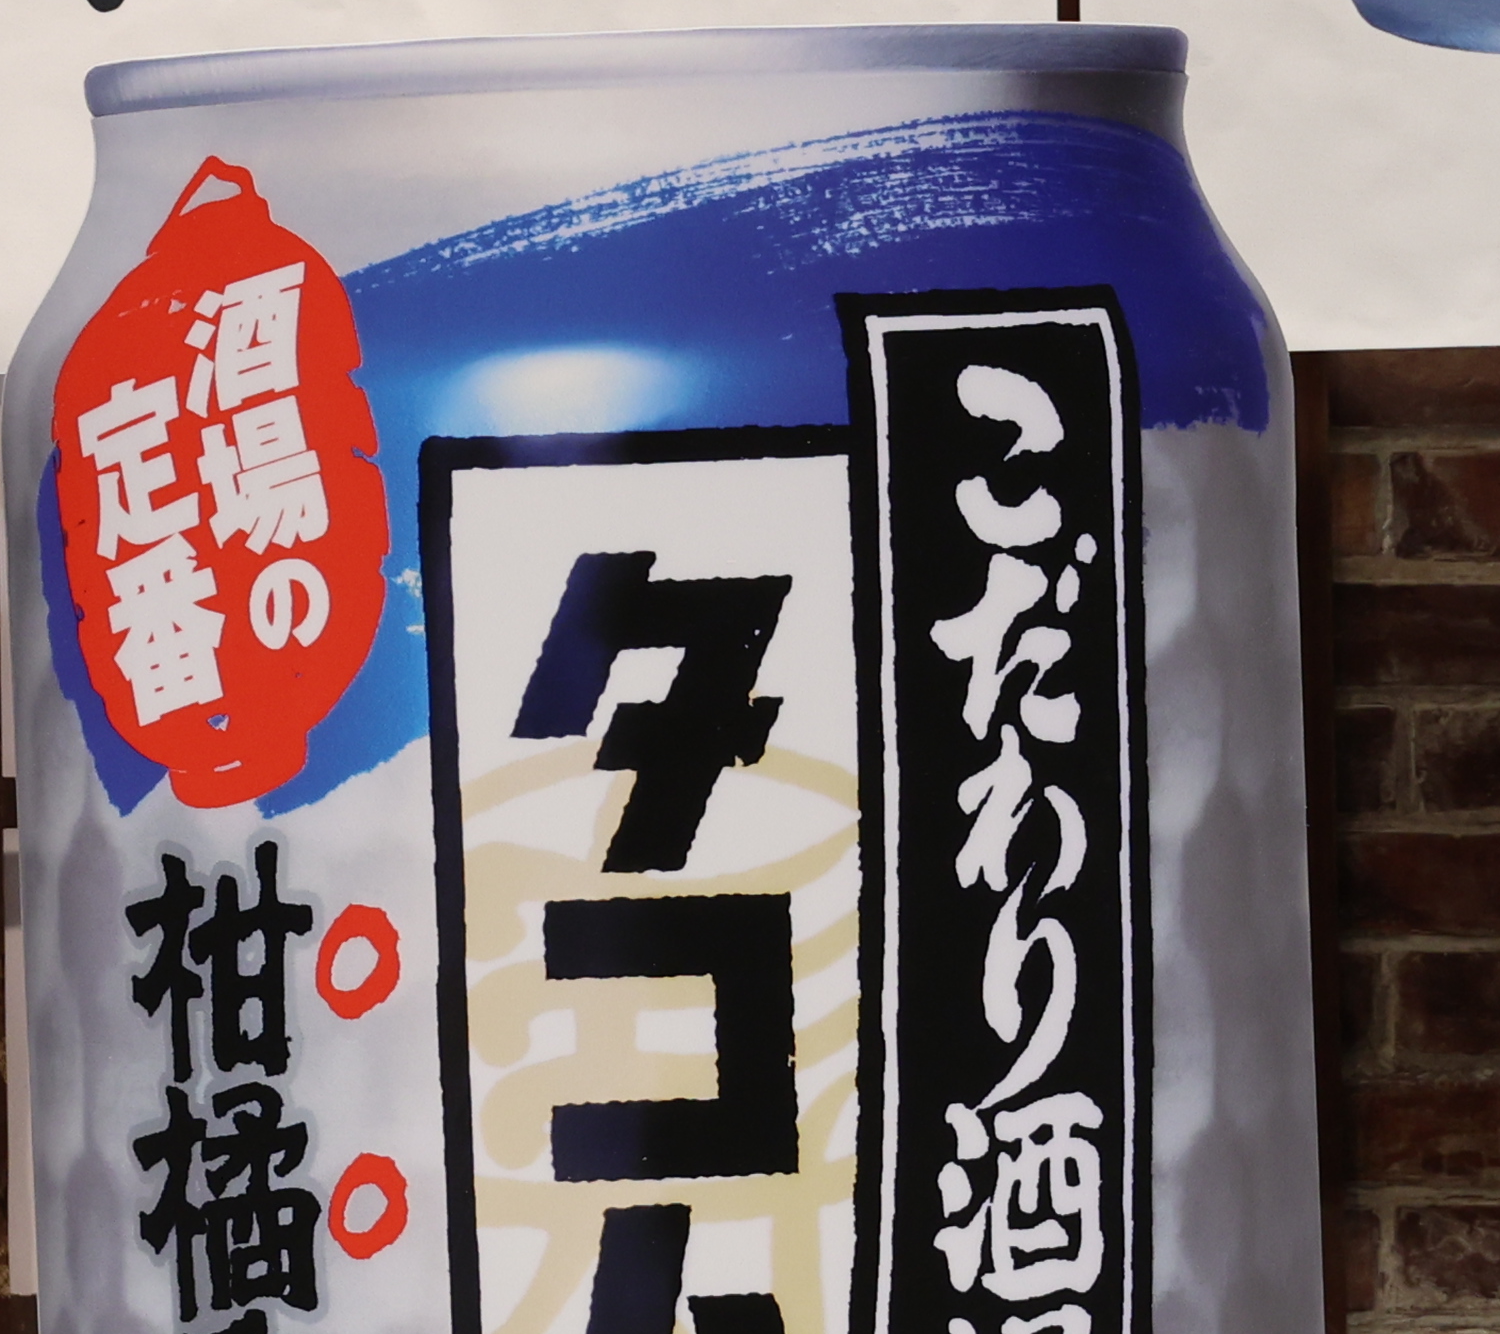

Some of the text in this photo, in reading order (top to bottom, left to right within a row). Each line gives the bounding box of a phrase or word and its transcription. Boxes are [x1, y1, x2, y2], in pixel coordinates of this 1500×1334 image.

[76, 376, 227, 730] 定番
[183, 262, 331, 651] 酒場の
